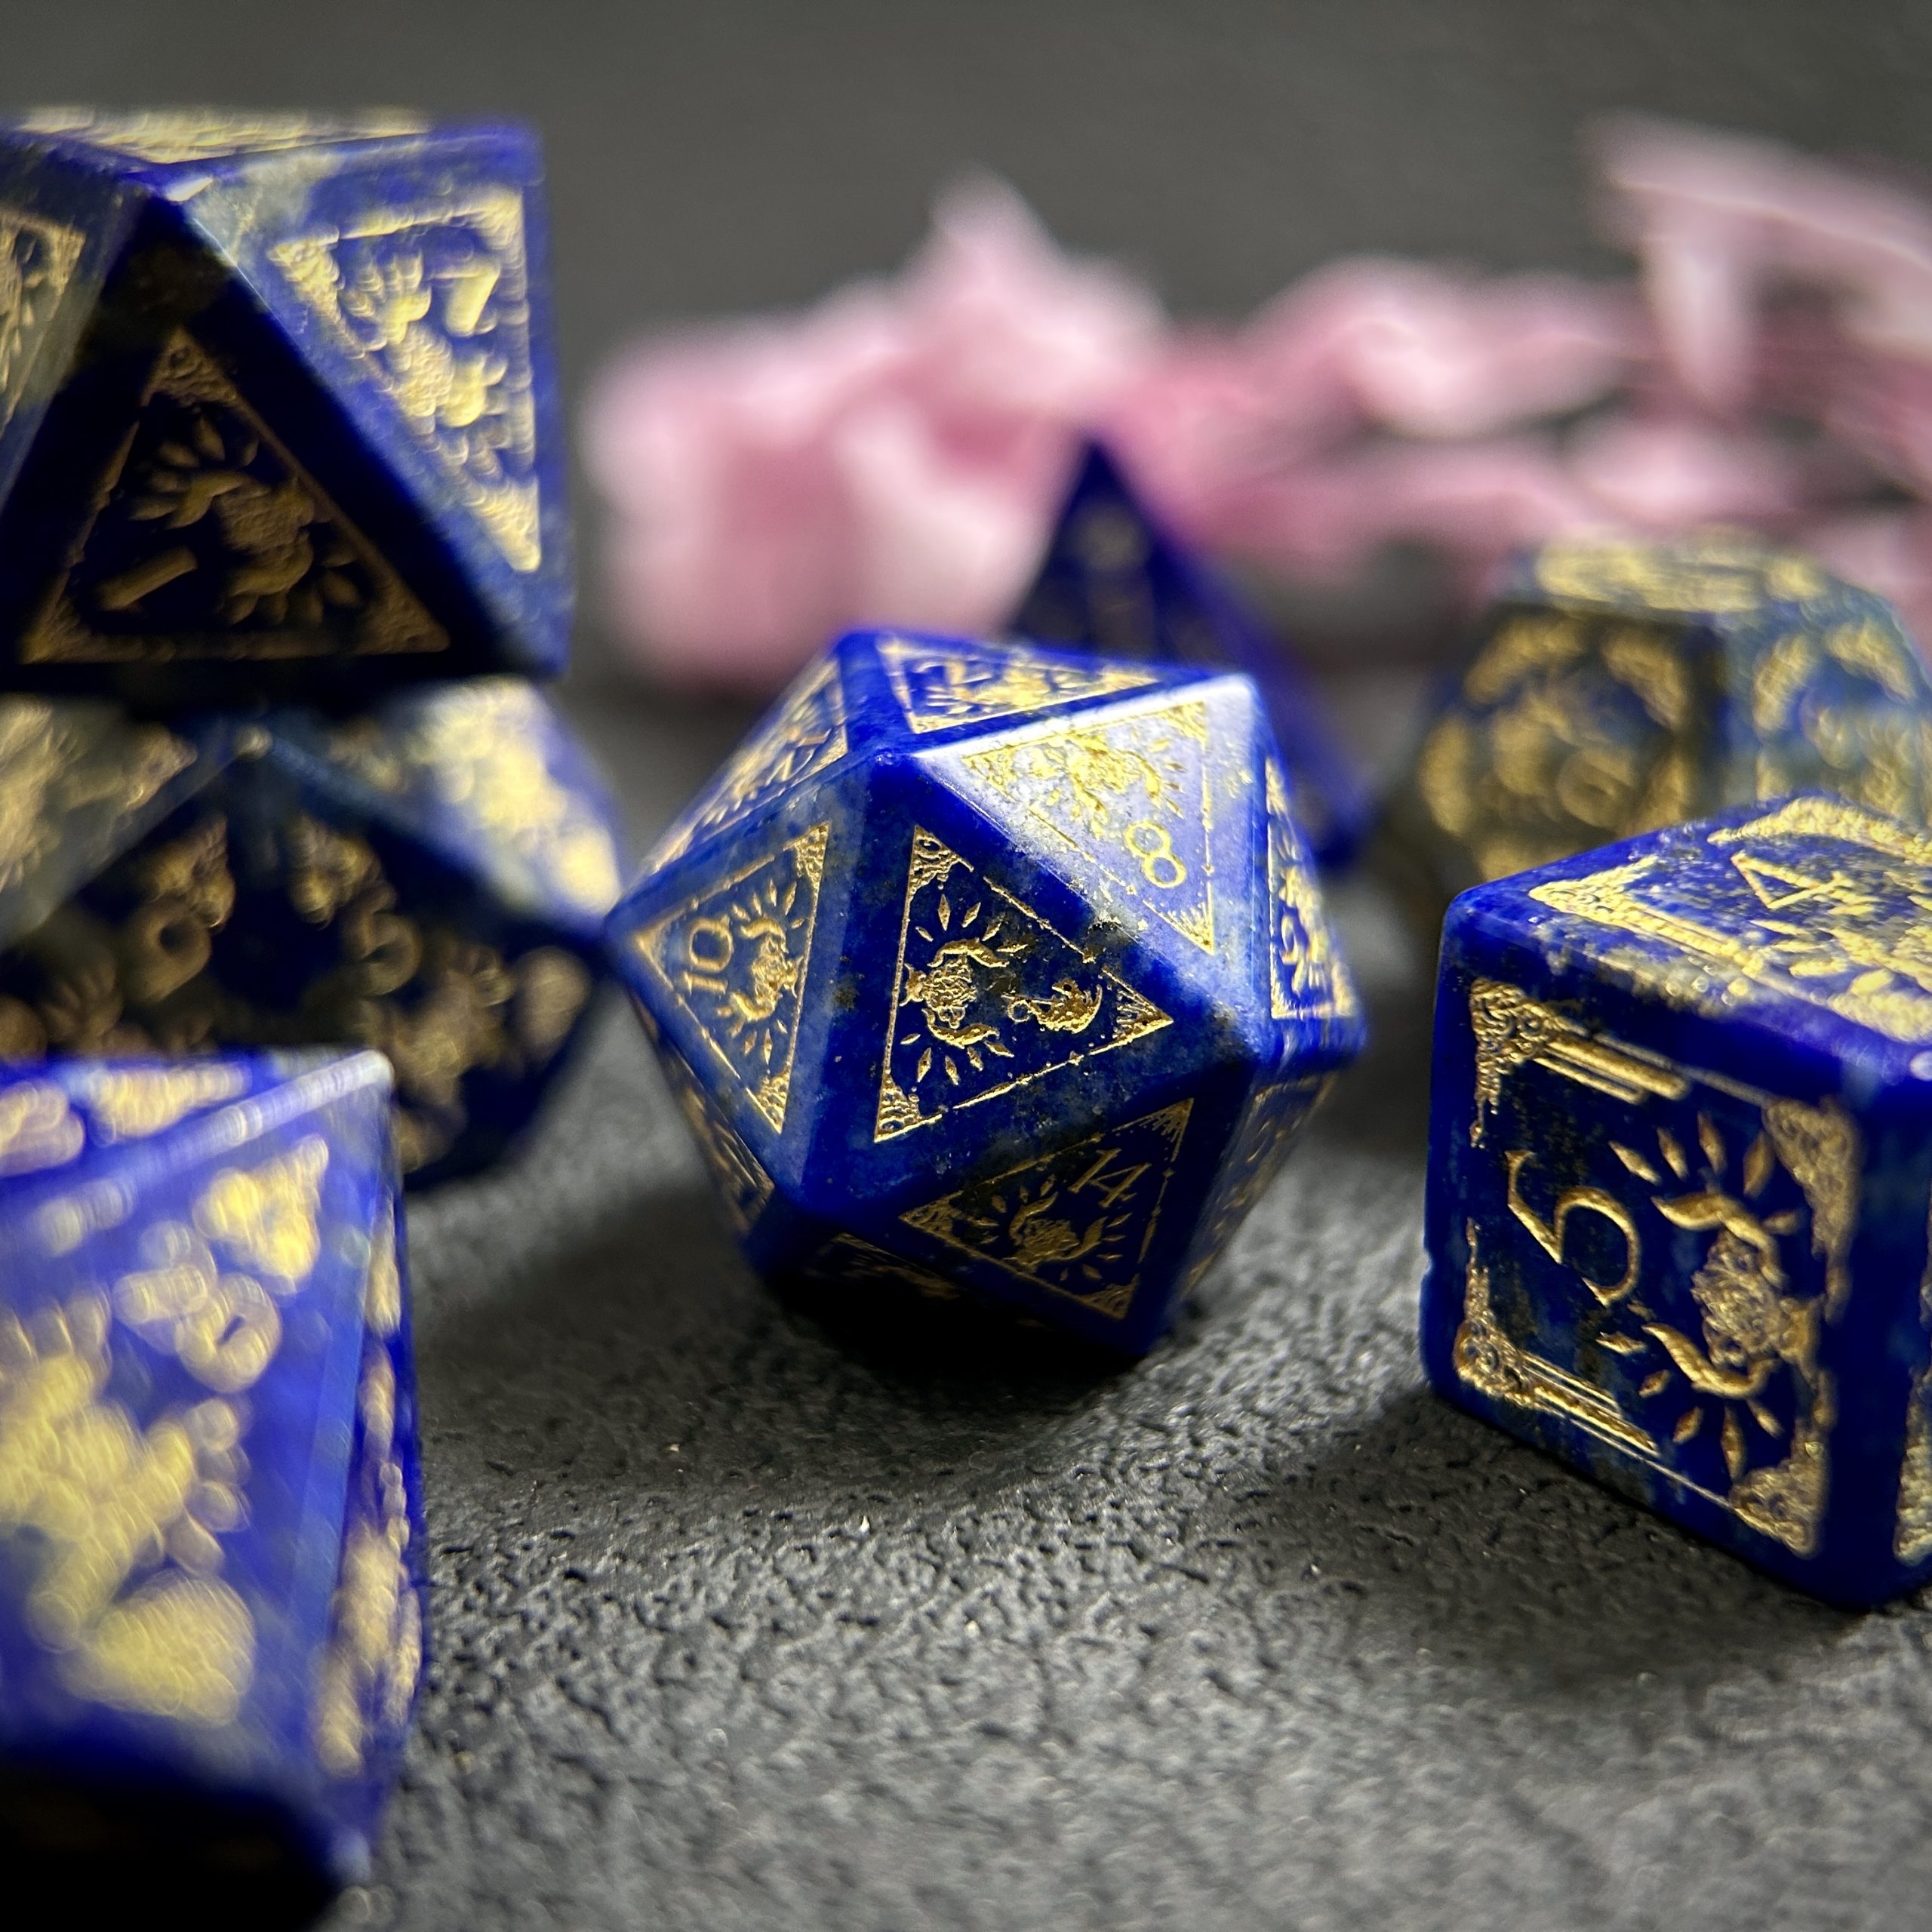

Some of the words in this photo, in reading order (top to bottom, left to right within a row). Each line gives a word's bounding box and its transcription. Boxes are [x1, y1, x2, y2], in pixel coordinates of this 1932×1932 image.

[1123, 820, 1188, 889] 8
[1730, 854, 1857, 910] 4
[683, 916, 734, 995] 10
[1066, 1146, 1153, 1209] 14
[1503, 1149, 1642, 1308] 5
